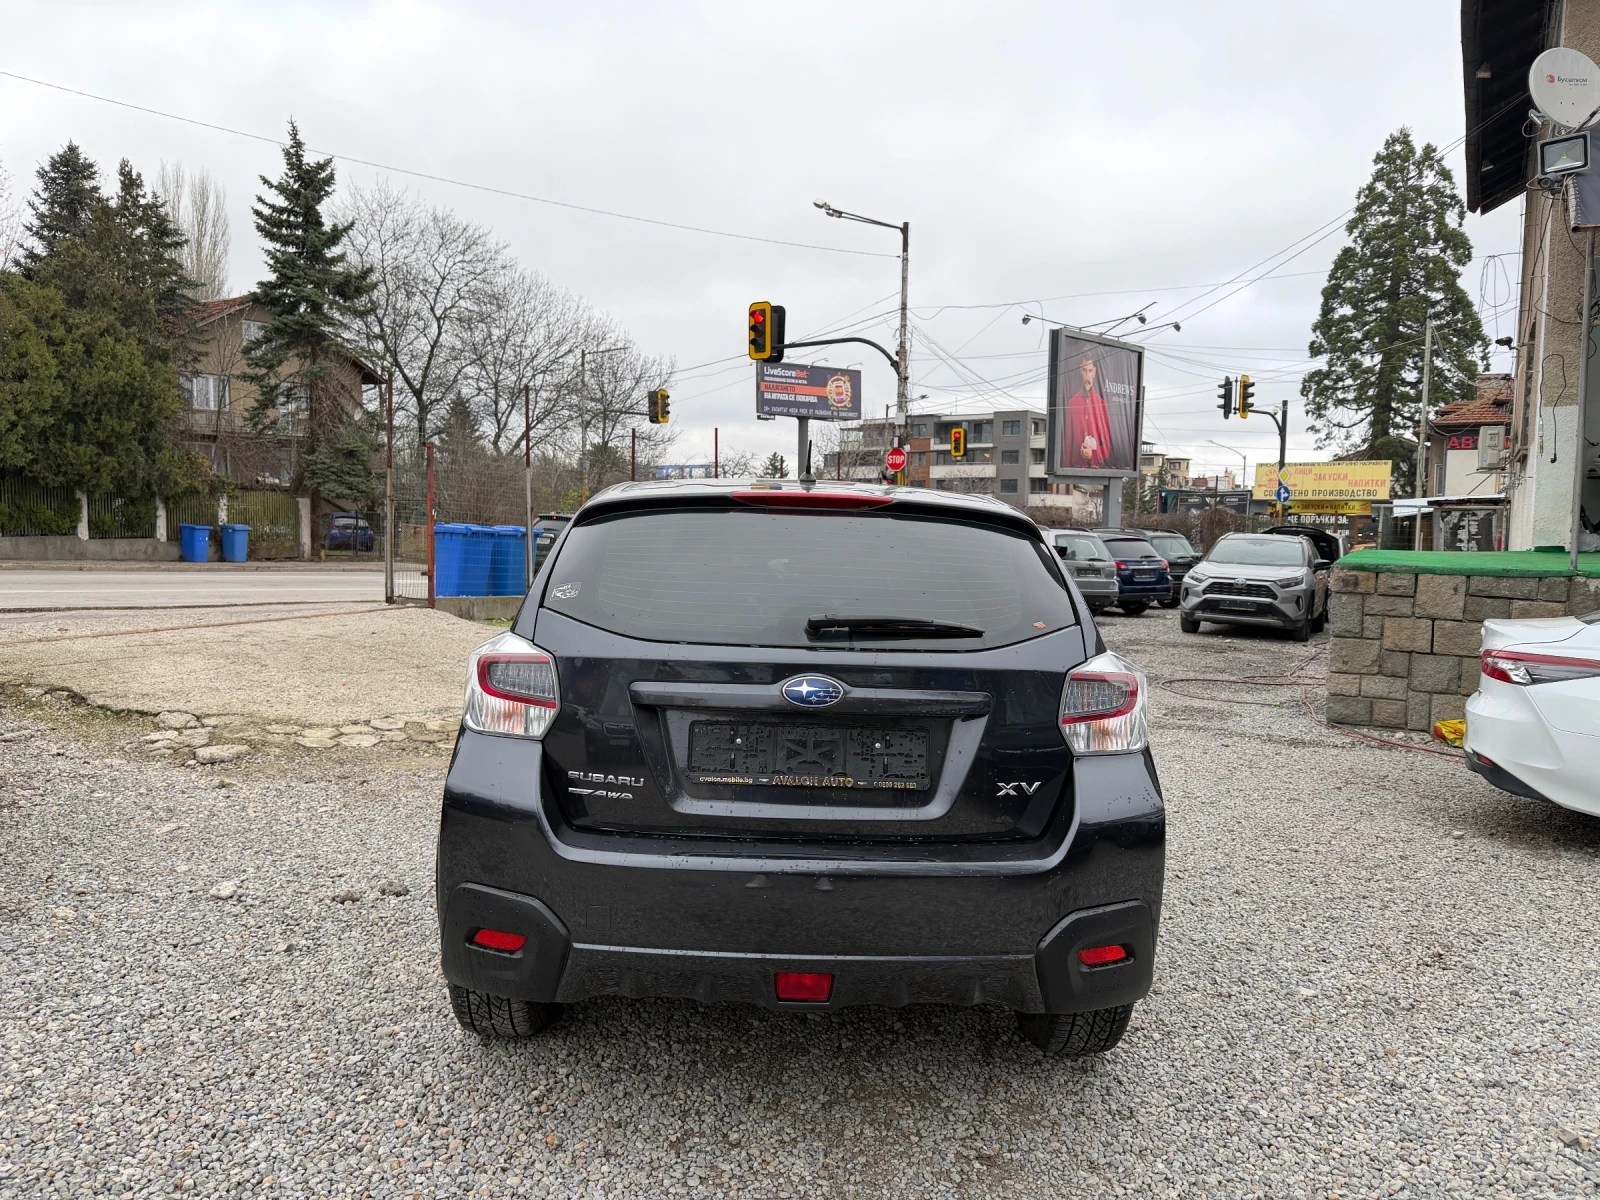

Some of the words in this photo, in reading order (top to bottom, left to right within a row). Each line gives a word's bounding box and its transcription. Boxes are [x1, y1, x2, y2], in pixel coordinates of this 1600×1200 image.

[888, 456, 905, 464] STOP
[1314, 473, 1348, 481] ЗАКУСКИ
[1348, 479, 1386, 488] НАПИТКИ
[1312, 489, 1378, 498] ПРОИЗВОДСТВО
[1302, 516, 1335, 524] ПОРЪЧКИ
[568, 770, 644, 786] SUBARU
[772, 776, 818, 786] AVALON
[822, 777, 854, 788] AUTO
[996, 782, 1042, 796] XV
[591, 790, 634, 799] AWD
